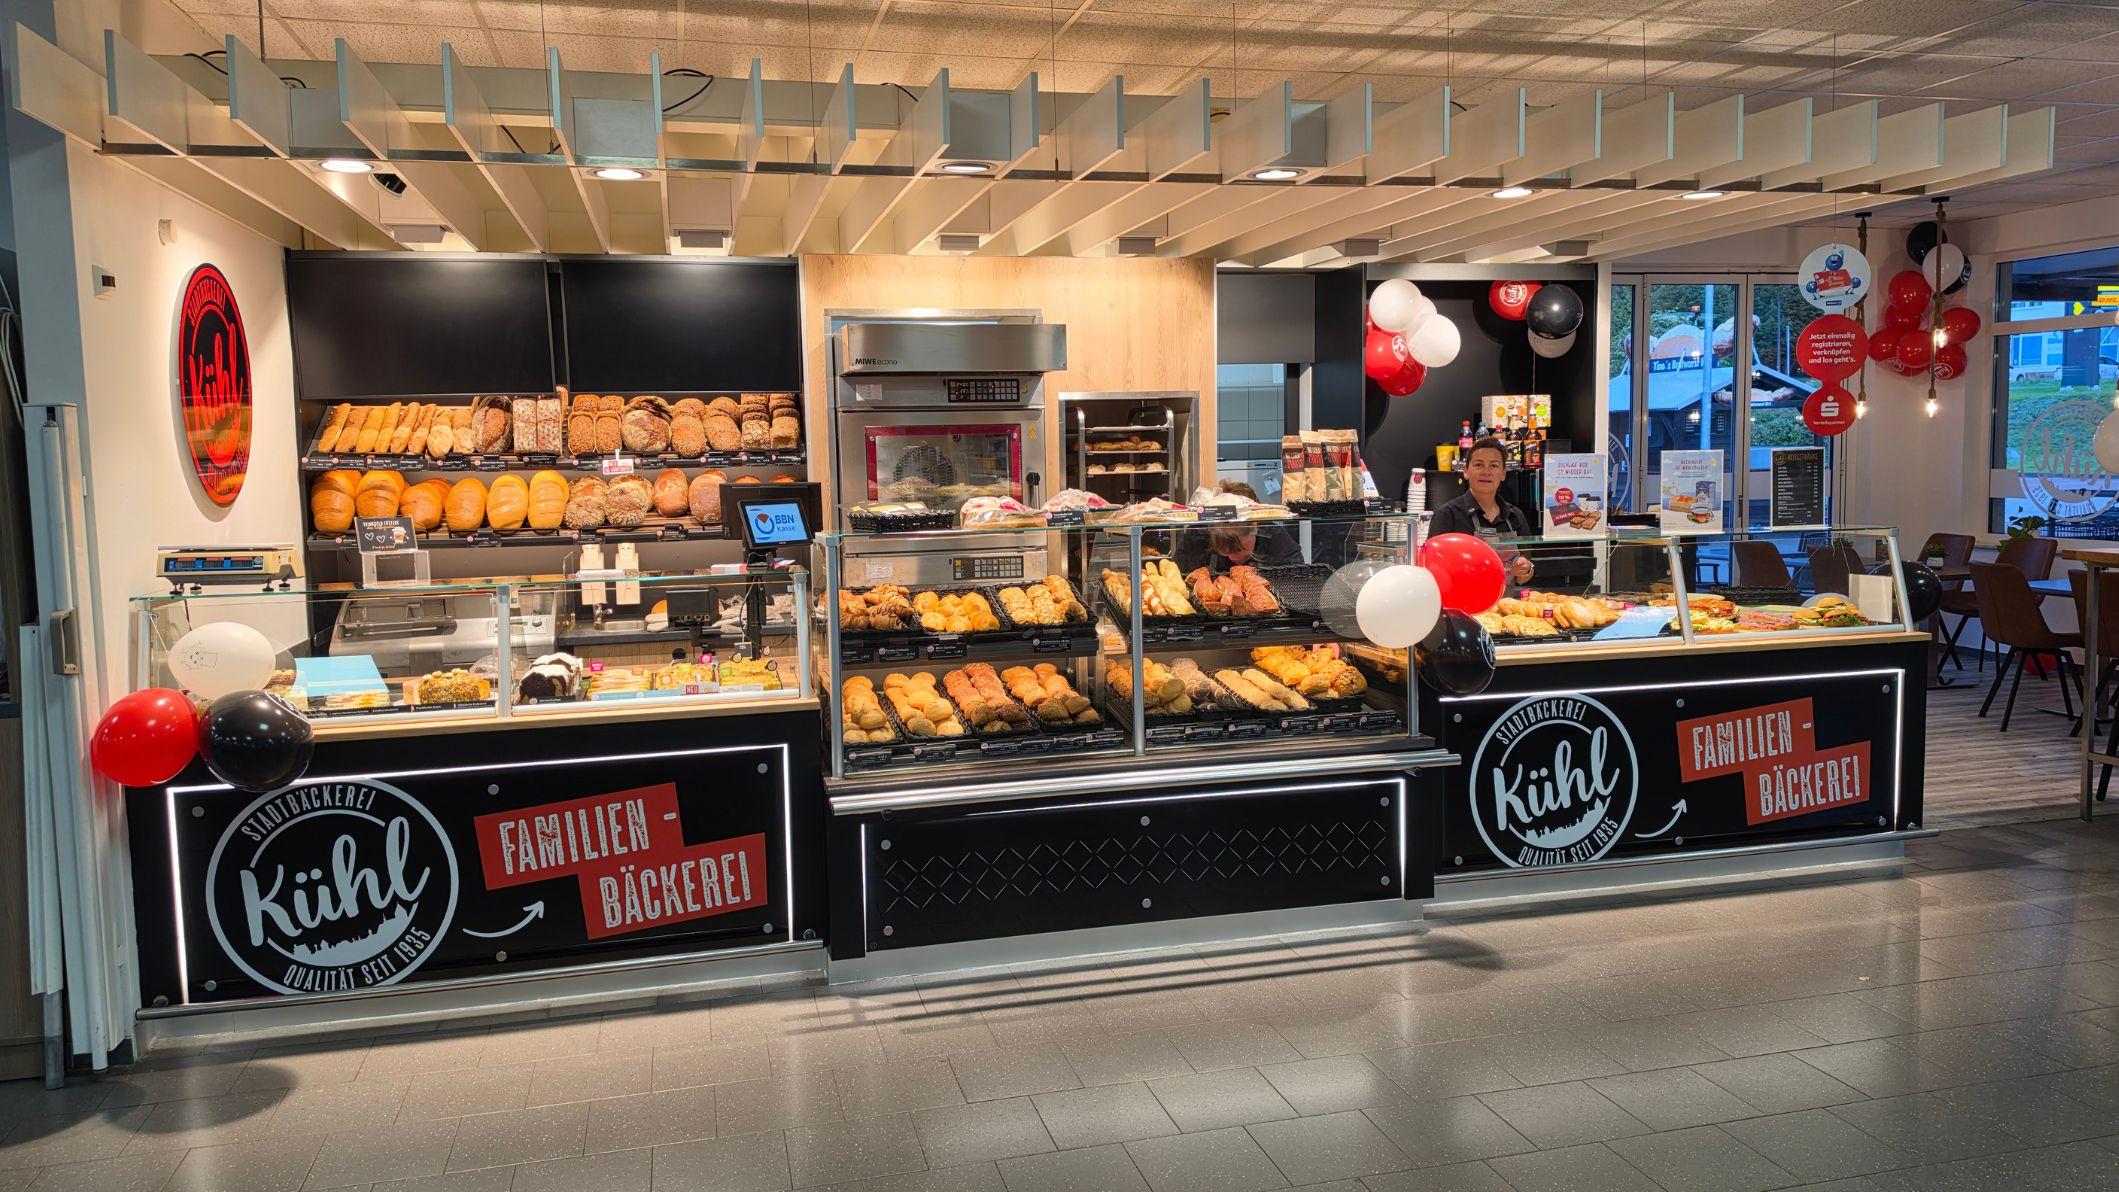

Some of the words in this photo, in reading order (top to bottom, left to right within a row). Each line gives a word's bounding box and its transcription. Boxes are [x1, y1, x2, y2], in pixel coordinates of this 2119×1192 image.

[1811, 341, 1852, 349] registrieren,
[1827, 332, 1856, 340] einmalig
[188, 323, 243, 432] Kühl
[775, 514, 795, 524] BBN
[686, 684, 698, 695] NEU
[1496, 700, 1587, 745] STADTBÄCKEREI
[1691, 709, 1794, 772] FAMILIEN
[1492, 725, 1620, 831] Kühl
[1758, 754, 1861, 818] BÄCKEREI
[240, 785, 375, 842] STADTBÄCKEREI
[498, 798, 650, 875] FAMILIEN
[1516, 844, 1569, 867] QUALITÄT
[1569, 836, 1596, 864] SEIT
[1593, 815, 1619, 848] 1935
[239, 816, 430, 947] Kühl
[600, 849, 753, 930] BÄCKEREI
[283, 962, 357, 992] QUALITÄT
[363, 954, 399, 986] SEIT
[395, 925, 434, 966] 1935
